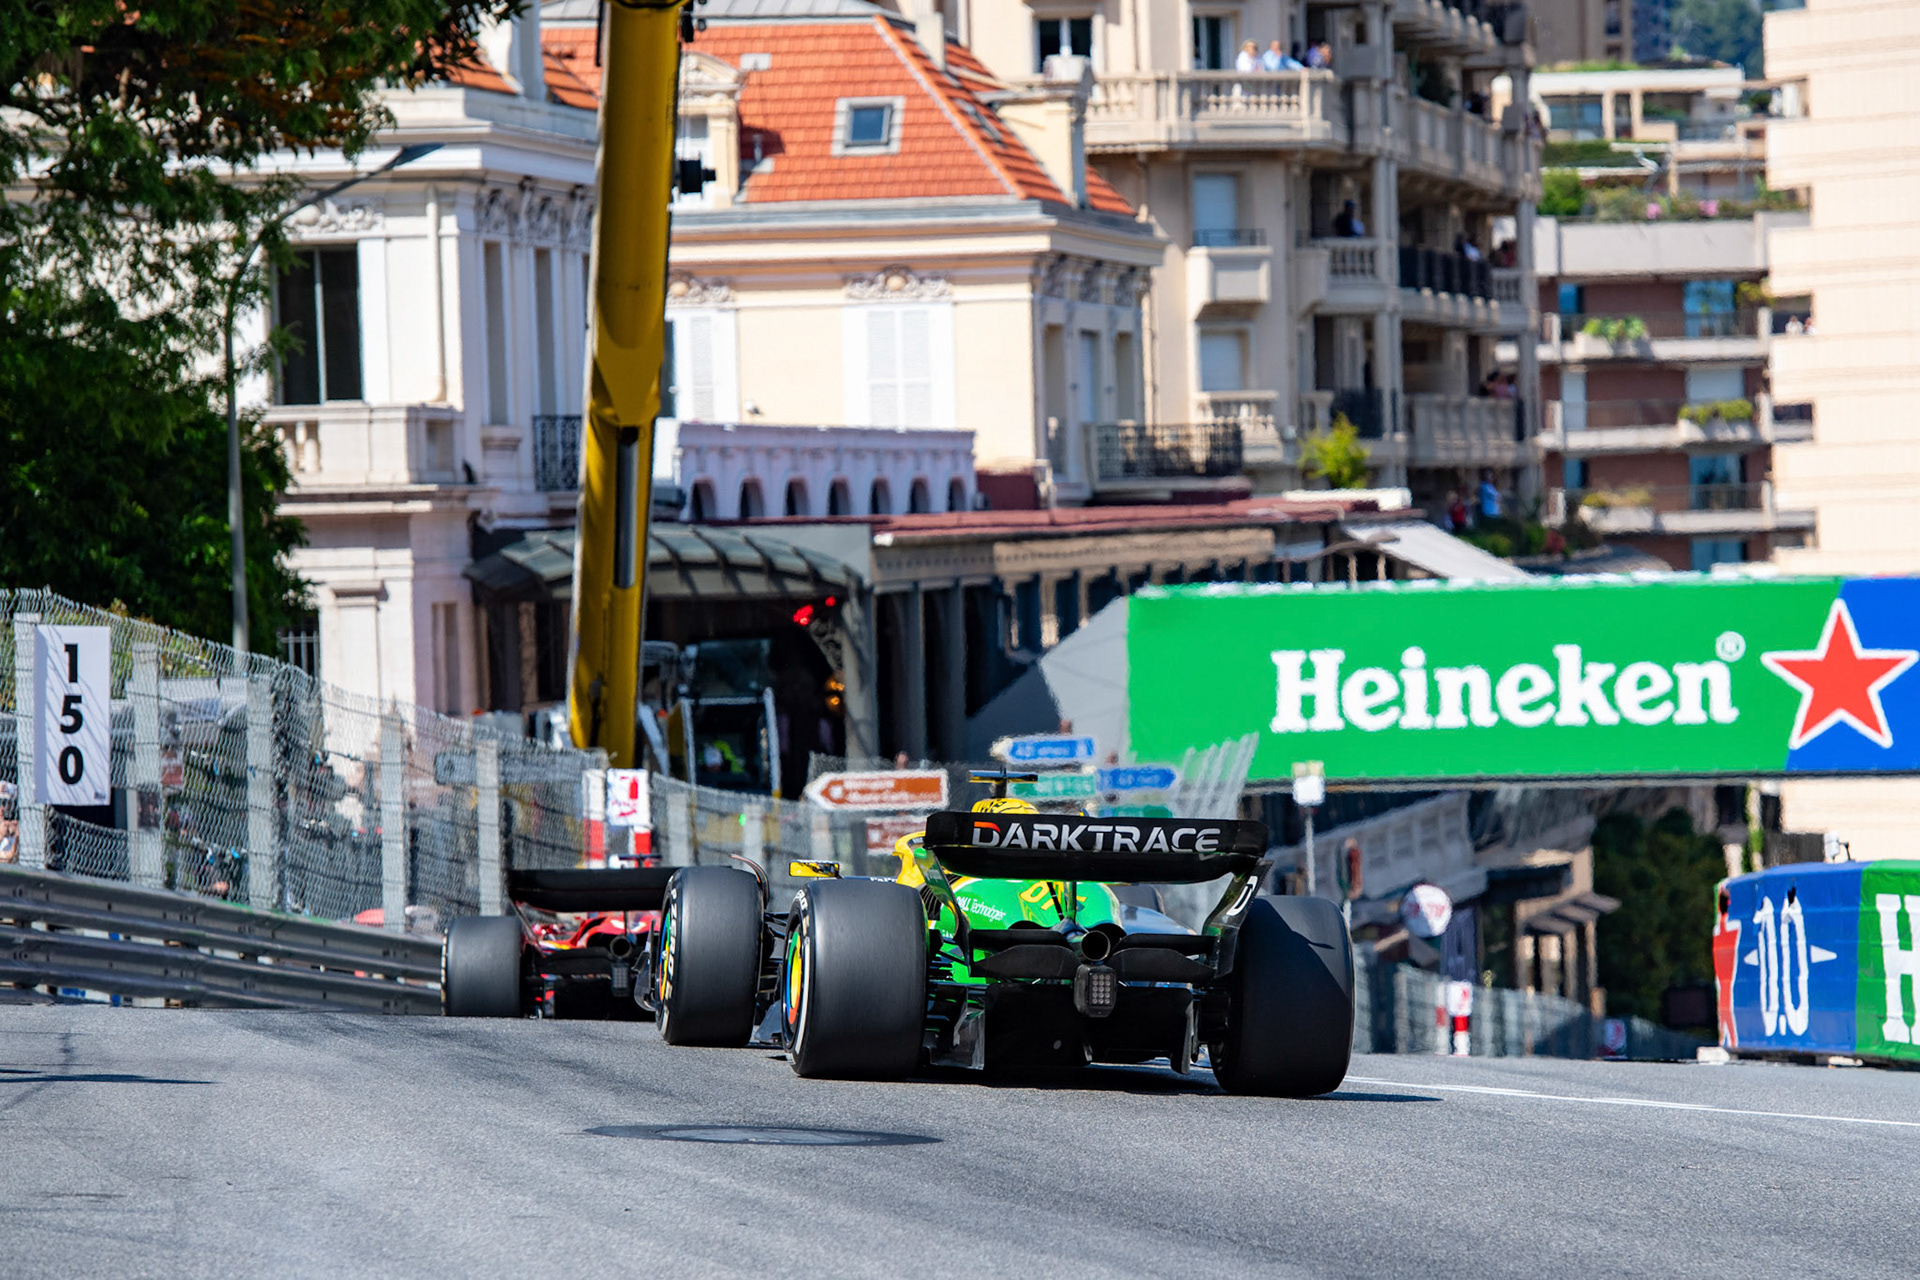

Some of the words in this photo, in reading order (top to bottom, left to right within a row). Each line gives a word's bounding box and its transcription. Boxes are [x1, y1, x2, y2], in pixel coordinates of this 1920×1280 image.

[58, 643, 84, 785] 150
[1269, 644, 1740, 733] Heineken
[972, 821, 1222, 853] DARKTRACE
[970, 899, 1006, 922] Technologies
